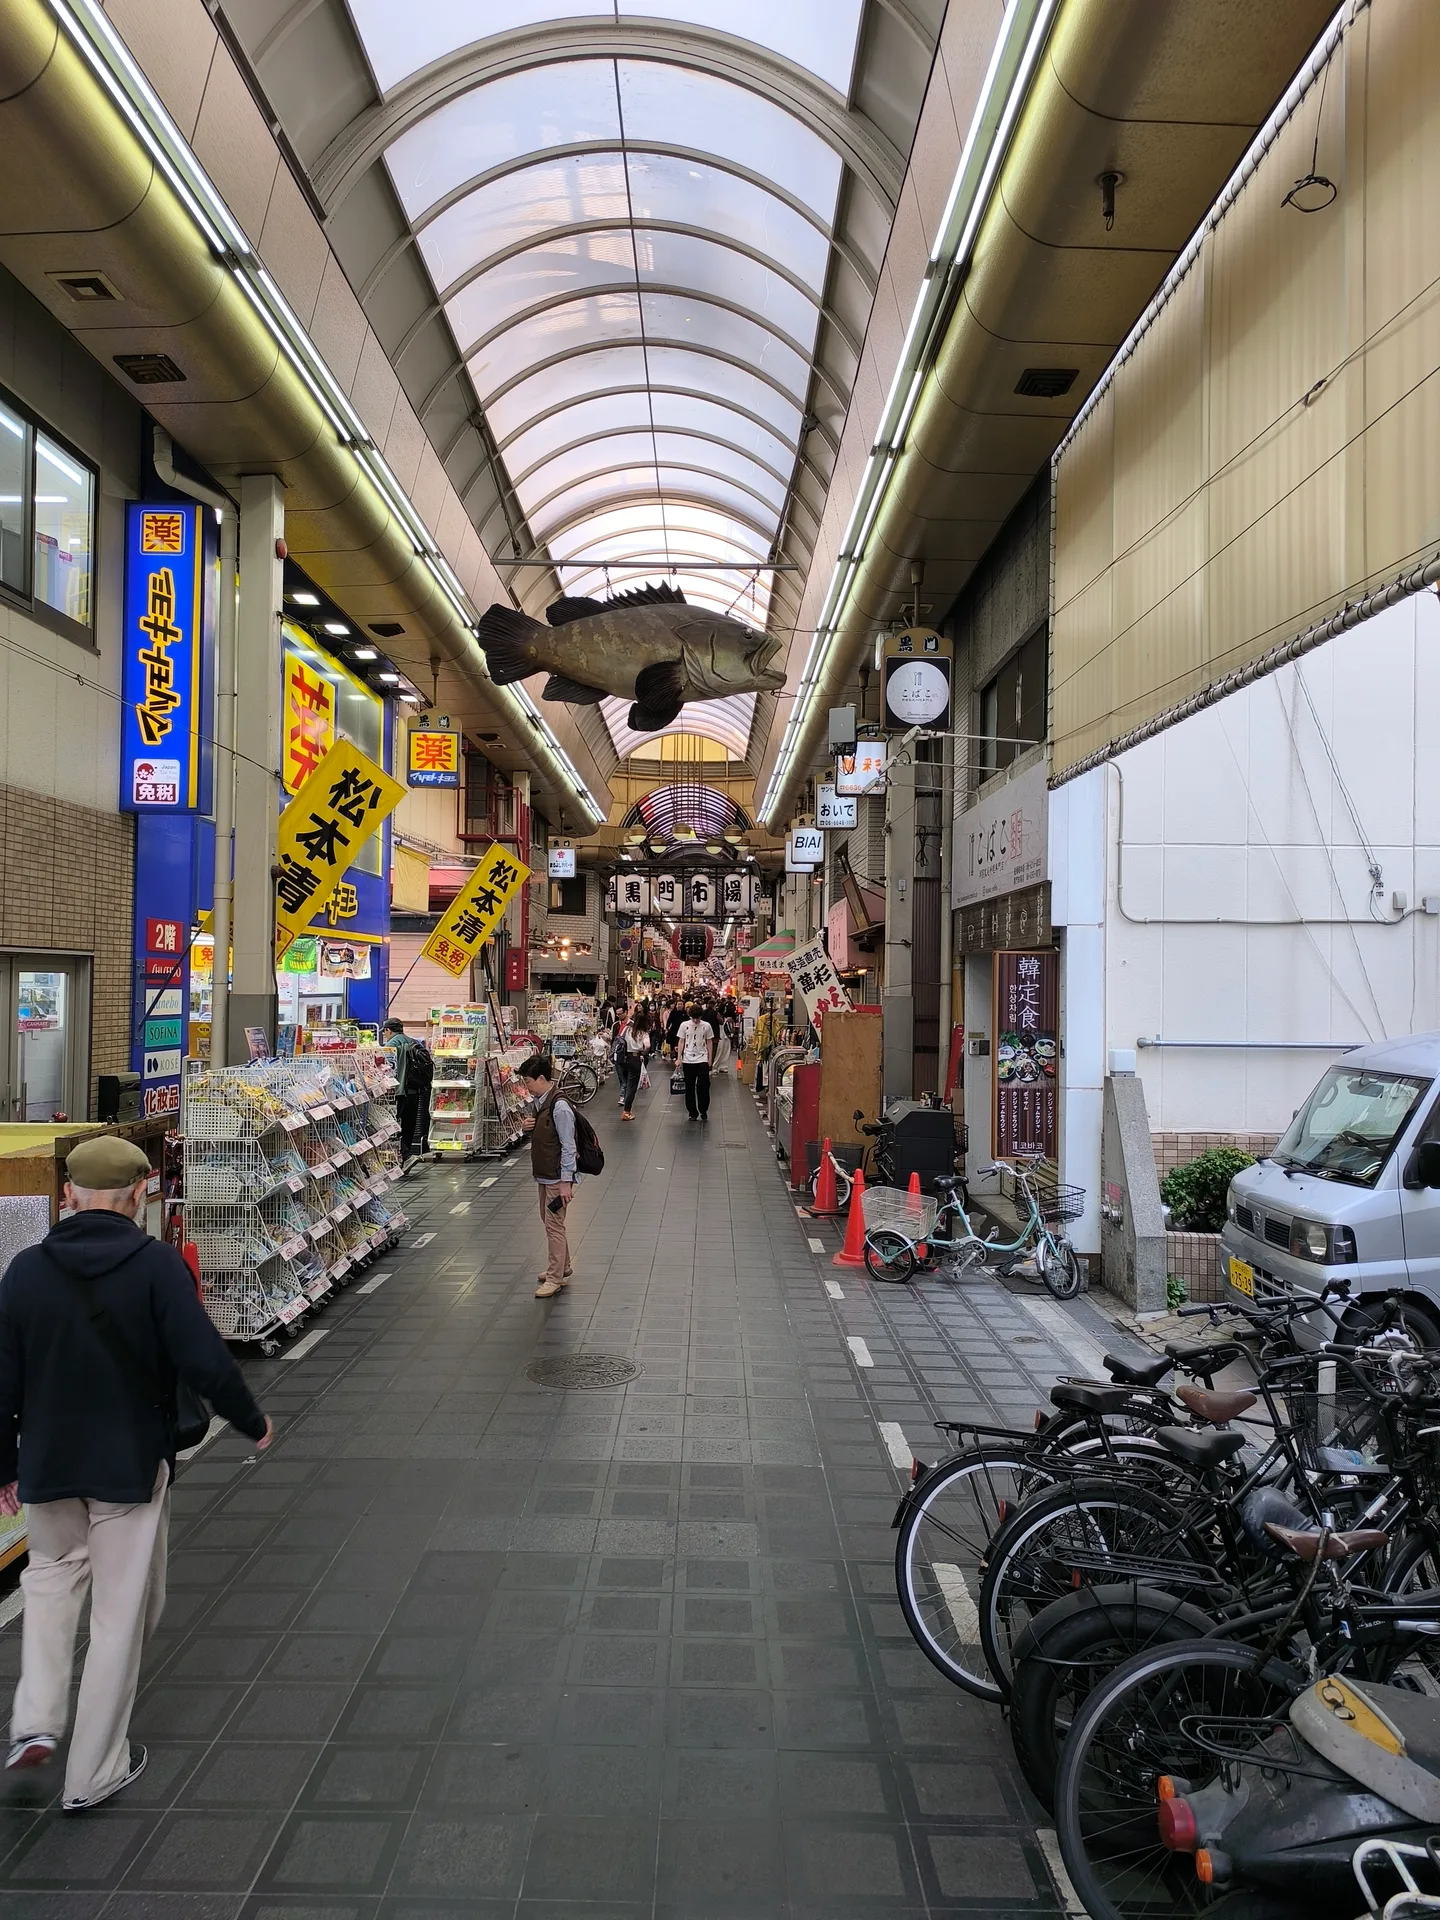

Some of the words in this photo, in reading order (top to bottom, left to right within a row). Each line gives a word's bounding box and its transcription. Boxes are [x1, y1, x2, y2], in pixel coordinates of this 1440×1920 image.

[145, 516, 180, 550] 薬
[137, 568, 182, 745] マツモトキヨシ
[898, 636, 939, 653] 黒門
[902, 688, 931, 698] こばこ
[418, 715, 450, 728] 黒門
[416, 734, 451, 770] 薬
[410, 772, 457, 784] マツモトキヨシ
[138, 784, 174, 801] 免税
[820, 803, 854, 817] おいで
[278, 767, 383, 915] 松本清
[795, 836, 822, 848] BIAI
[451, 859, 518, 945] 松本清
[625, 879, 742, 903] 黒門市場
[155, 923, 177, 951] 2階
[435, 940, 464, 967] 免税
[787, 946, 823, 973] 製造直売
[1008, 984, 1017, 1023] 한상차림
[1017, 957, 1041, 1029] 韓定食
[149, 1026, 178, 1041] SOFINA
[160, 1057, 179, 1072] KOSÉ
[144, 1084, 179, 1114] 化粧品
[1019, 1141, 1044, 1150] 코바코
[1235, 1271, 1252, 1293] 25-39
